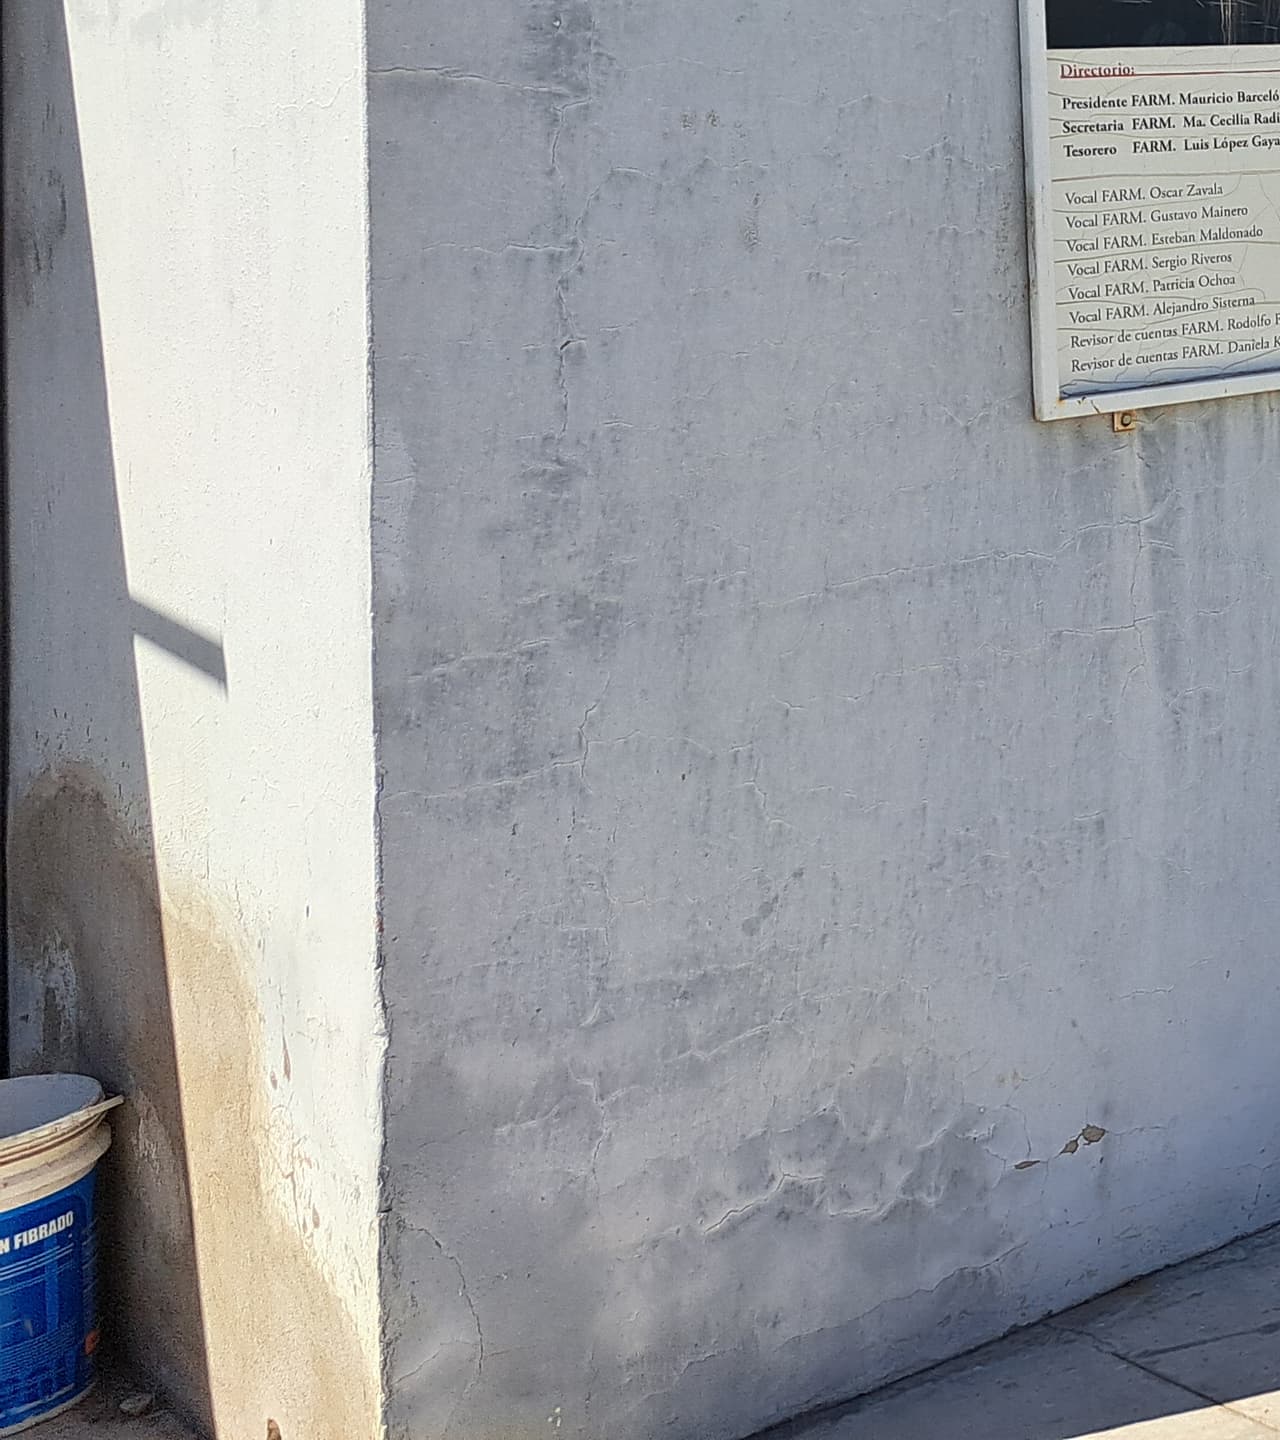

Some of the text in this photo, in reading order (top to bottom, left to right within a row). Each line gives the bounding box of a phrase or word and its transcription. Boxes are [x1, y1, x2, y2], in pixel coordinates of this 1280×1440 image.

[1060, 63, 1135, 79] Directorio:
[1062, 89, 1280, 110] Presidente FARM. Mauricio Barceló
[1062, 119, 1124, 134] Secretaria
[1132, 117, 1175, 130] FARM.
[1183, 116, 1206, 128] Ma.
[1210, 114, 1250, 127] Cecilia
[1063, 135, 1280, 158] Tesorero FARM. Luis López Gaya
[1065, 183, 1223, 205] Vocal FARM. Oscar Zavala
[1065, 206, 1248, 229] Vocal FARM. Gustavo Mainero
[1066, 226, 1263, 252] Vocal FARM. Esteban Maldonado
[1067, 251, 1232, 277] Vocal FARM. Sergio Riveros
[1068, 275, 1236, 300] Vocal FARM. Patricia Ochoa
[1069, 295, 1255, 324] Vocal FARM. Alejandro Sisterna
[1071, 333, 1114, 349] Revisor
[1117, 330, 1132, 343] de
[1134, 327, 1178, 342] cuentas
[1181, 320, 1223, 335] FARM.
[1227, 315, 1272, 331] Rodolfo
[1071, 357, 1115, 373] Revisor
[1118, 354, 1132, 367] de
[1135, 350, 1178, 365] cuentas
[1182, 343, 1224, 359] FARM.
[1227, 339, 1270, 354] Daniela
[14, 1210, 74, 1250] FIBRADO
